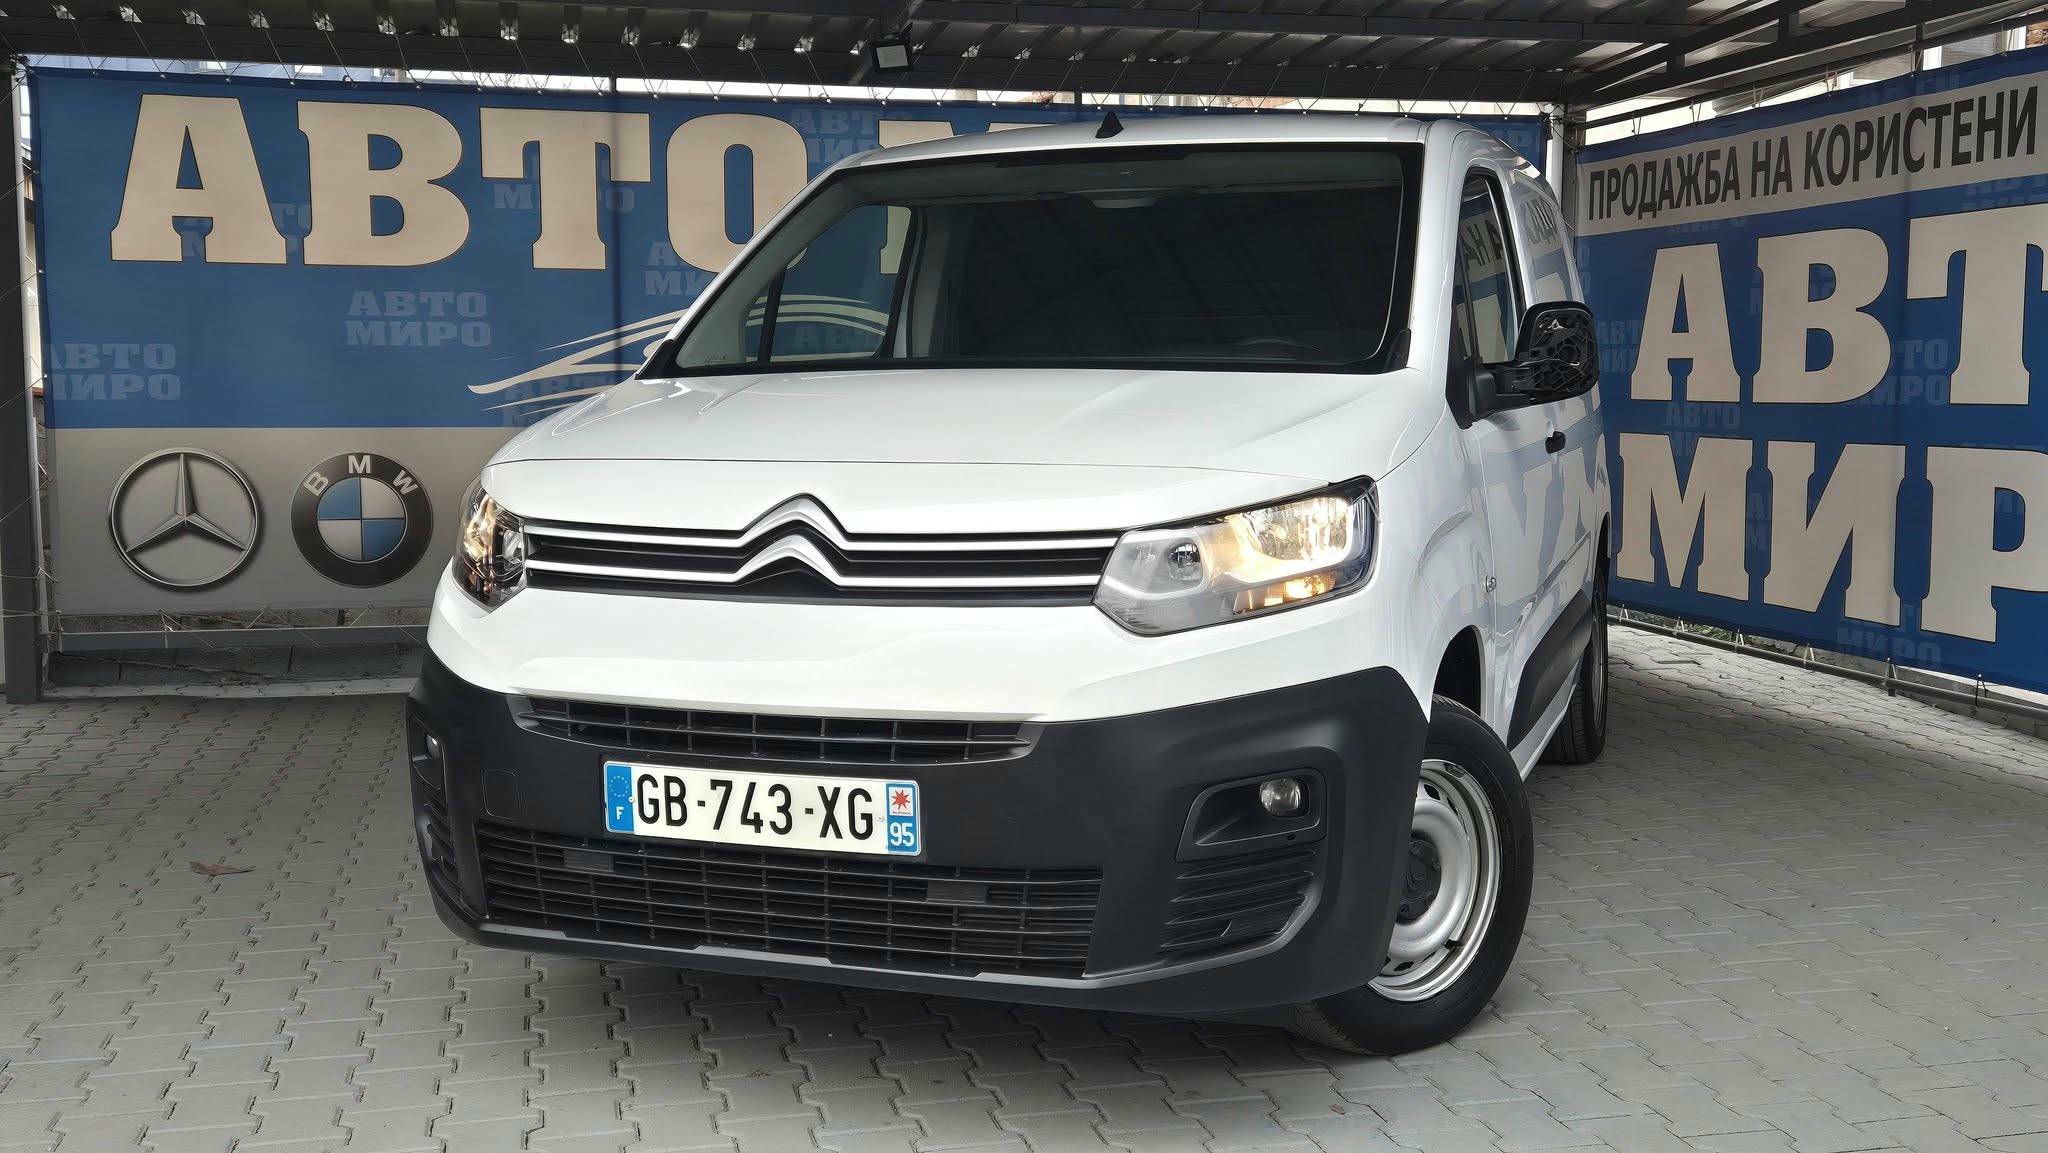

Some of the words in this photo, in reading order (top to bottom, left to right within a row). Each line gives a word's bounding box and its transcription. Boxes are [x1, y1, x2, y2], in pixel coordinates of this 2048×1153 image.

[1588, 146, 1740, 220] ПРОДАЖБА
[1750, 136, 1792, 198] НА
[1803, 86, 2038, 190] КОРИСТЕНИ
[111, 94, 808, 273] АВТО
[348, 290, 487, 318] АВТО
[344, 320, 491, 347] МИРО
[303, 455, 418, 496] BMW
[615, 806, 624, 821] F
[637, 774, 873, 841] GB-743-XG
[890, 821, 915, 847] 95
